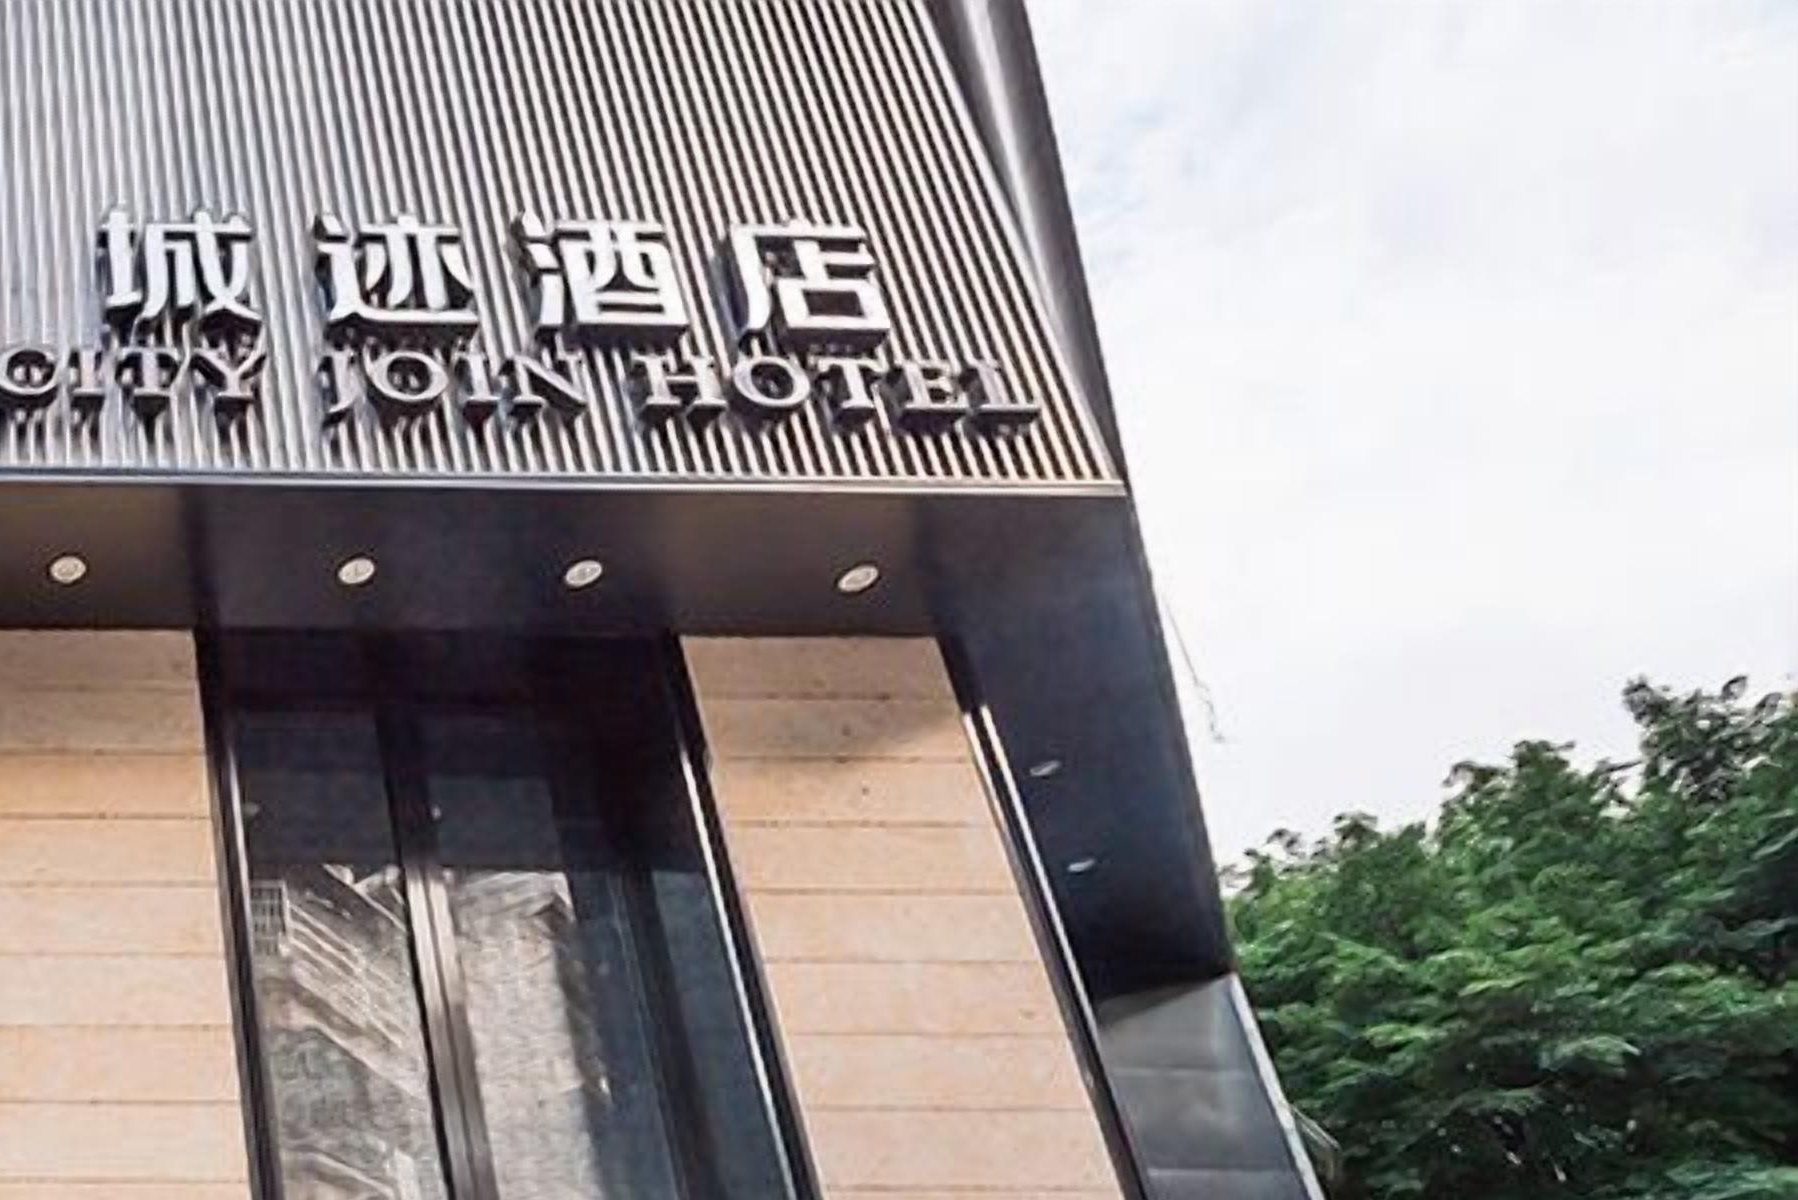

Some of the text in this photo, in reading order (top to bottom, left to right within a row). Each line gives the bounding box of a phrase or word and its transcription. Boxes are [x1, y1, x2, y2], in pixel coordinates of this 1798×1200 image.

[98, 210, 892, 334] 城迹酒店
[318, 348, 587, 414] JOIN
[632, 353, 1042, 414] HOTEL
